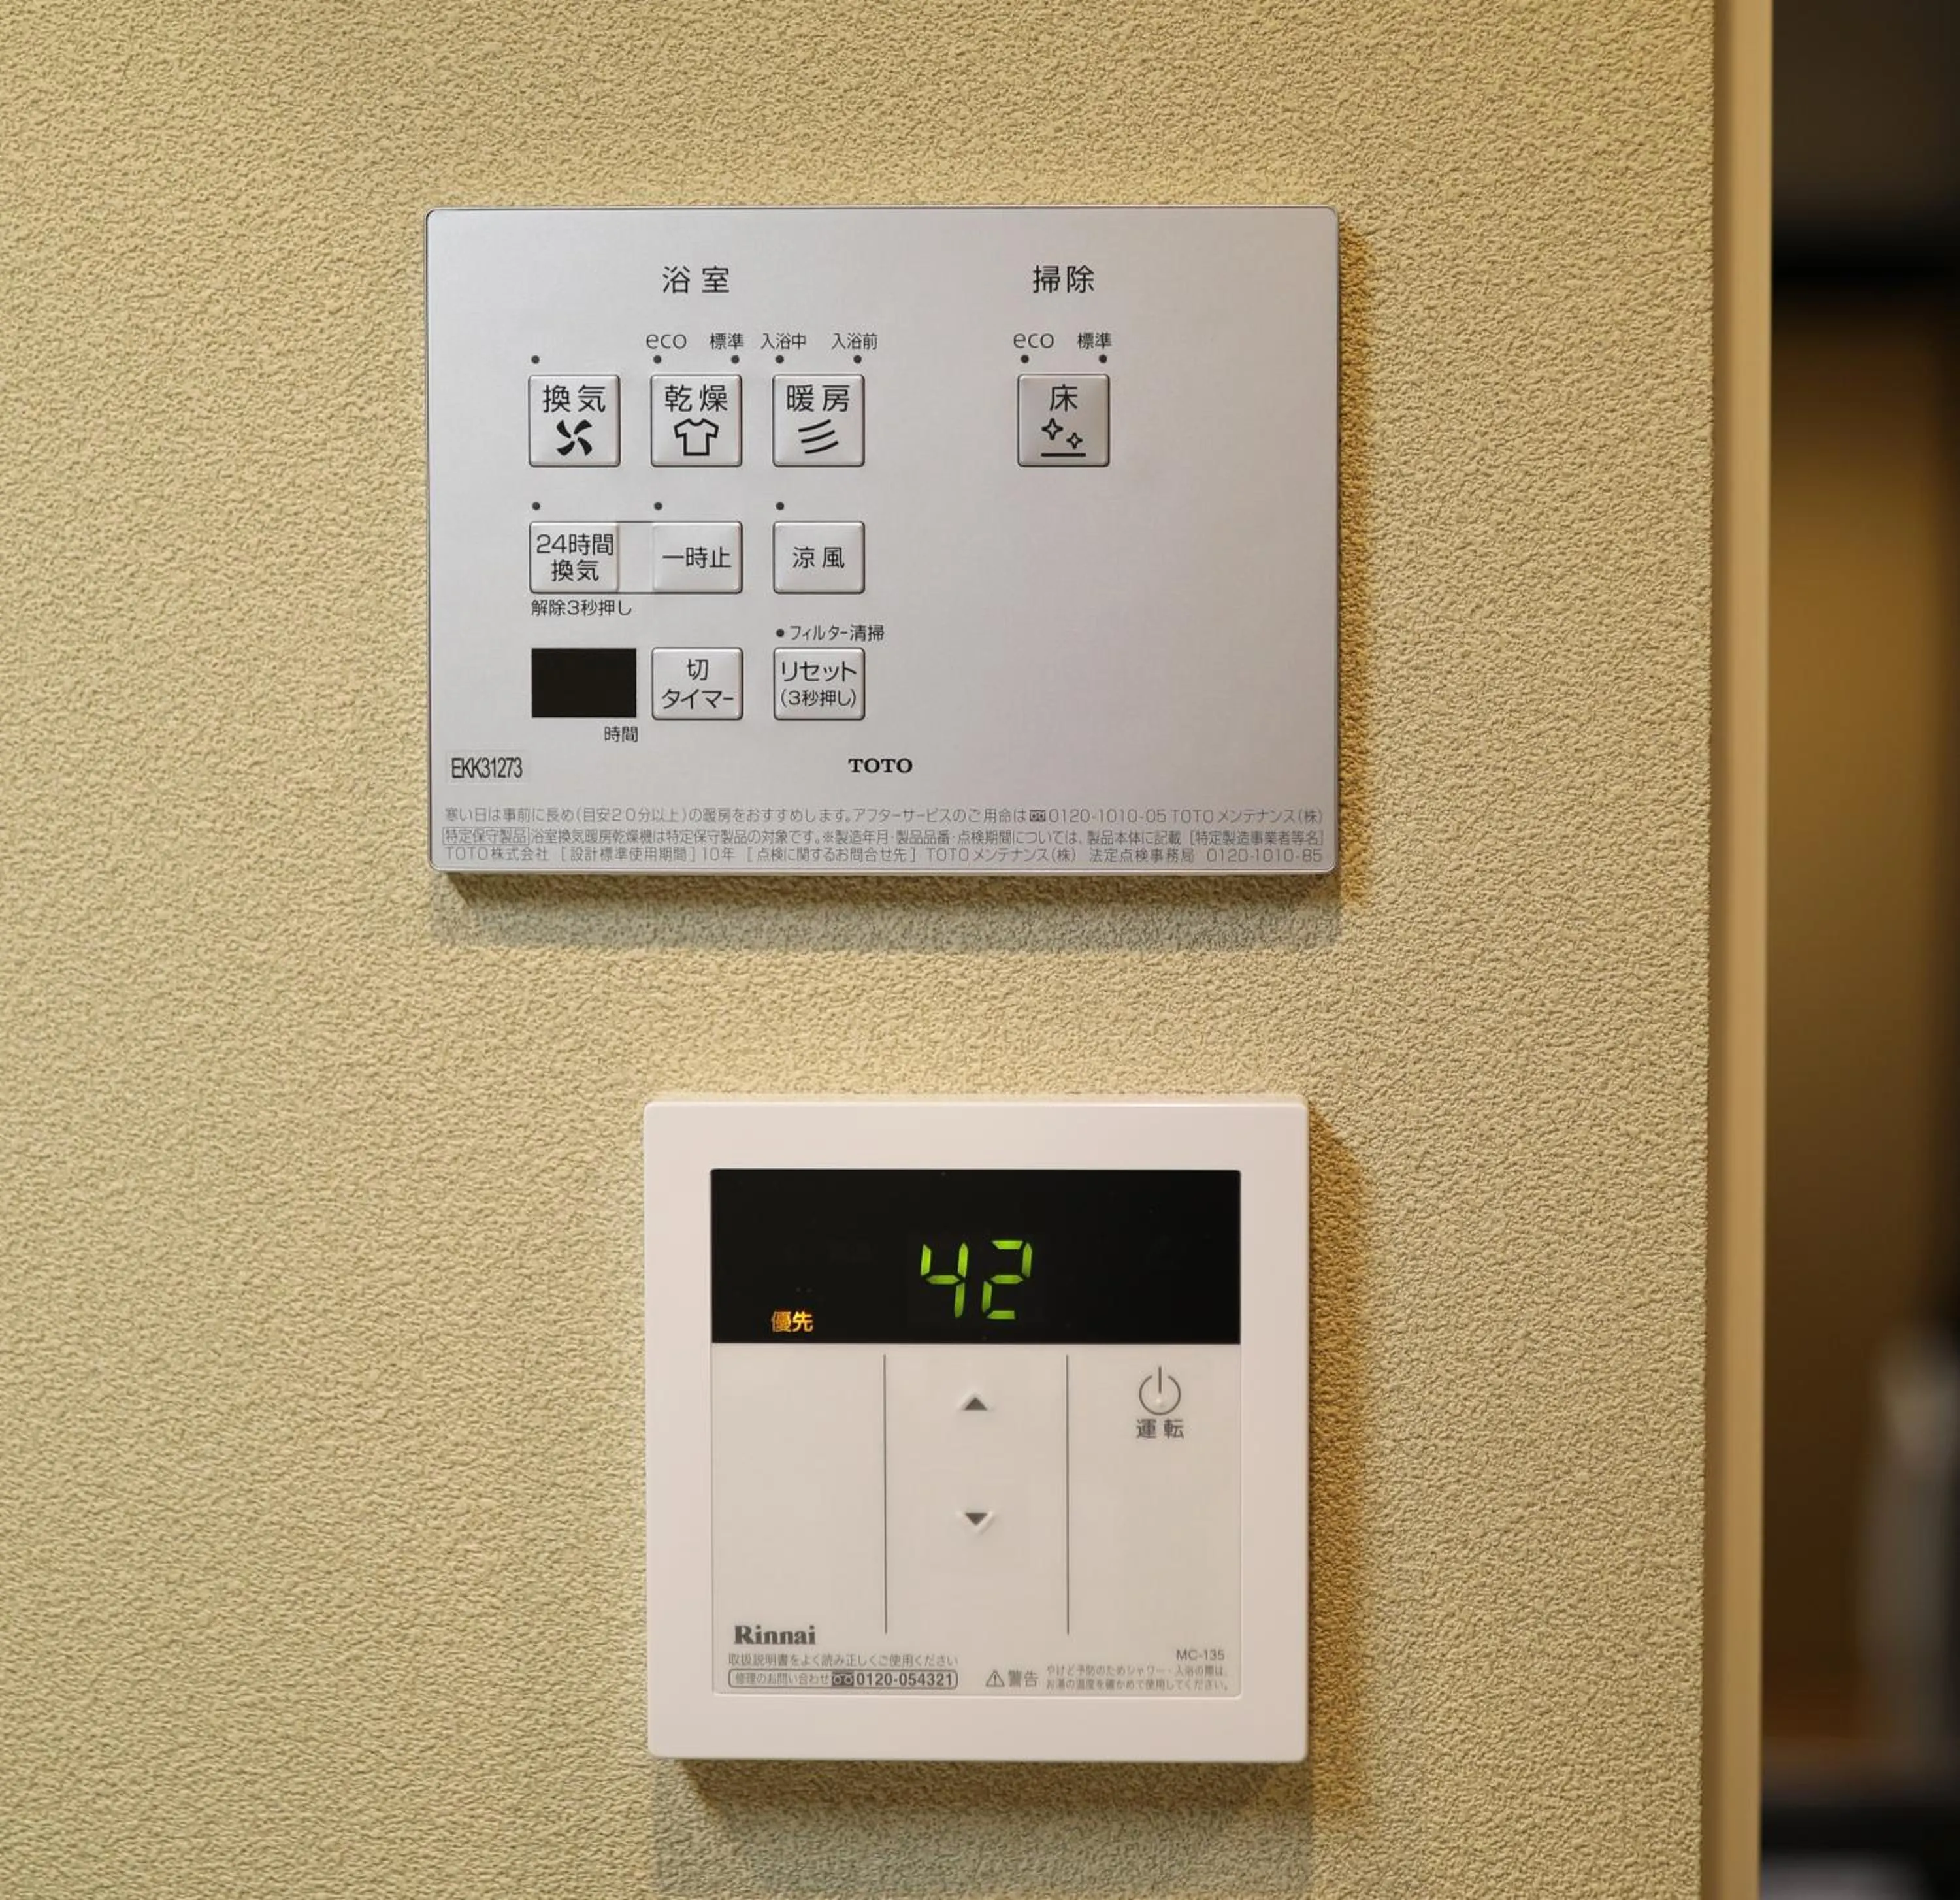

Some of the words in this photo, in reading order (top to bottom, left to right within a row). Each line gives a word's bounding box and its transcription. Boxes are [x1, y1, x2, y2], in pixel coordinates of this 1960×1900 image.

[663, 266, 729, 293] 浴室
[1033, 265, 1094, 293] 掃除
[646, 334, 687, 350] eco
[710, 333, 743, 350] 標準
[760, 333, 806, 350] 入浴中
[832, 333, 877, 350] 入浴前
[1014, 333, 1054, 348] eco
[1077, 333, 1111, 349] 標準
[543, 385, 606, 413] 換気
[665, 384, 728, 412] 乾燥
[787, 384, 850, 412] 暖房
[1050, 384, 1077, 412] 床
[537, 533, 613, 555] 24時間
[662, 546, 732, 568] 一時止
[793, 546, 845, 568] 涼風
[551, 559, 599, 581] 換気
[531, 599, 631, 616] 解除3秒押し
[791, 625, 884, 642] フィルター清掃
[687, 659, 708, 681] 切
[782, 661, 857, 682] リセット
[662, 689, 734, 709] タイマー
[781, 689, 856, 707] (3秒押し)
[604, 727, 638, 742] 時間
[451, 757, 523, 778] EKK31273
[848, 758, 912, 773] TOTO
[1048, 808, 1166, 824] 0120-1010-05
[1207, 848, 1323, 863] 0120-1010-85
[921, 1240, 1032, 1319] 42
[771, 1311, 813, 1332] 優先
[1137, 1418, 1184, 1439] 運転
[734, 1625, 815, 1645] Rinnai
[1176, 1648, 1224, 1661] MC-135
[856, 1671, 953, 1686] 0120-054321
[1007, 1669, 1038, 1688] 警告
